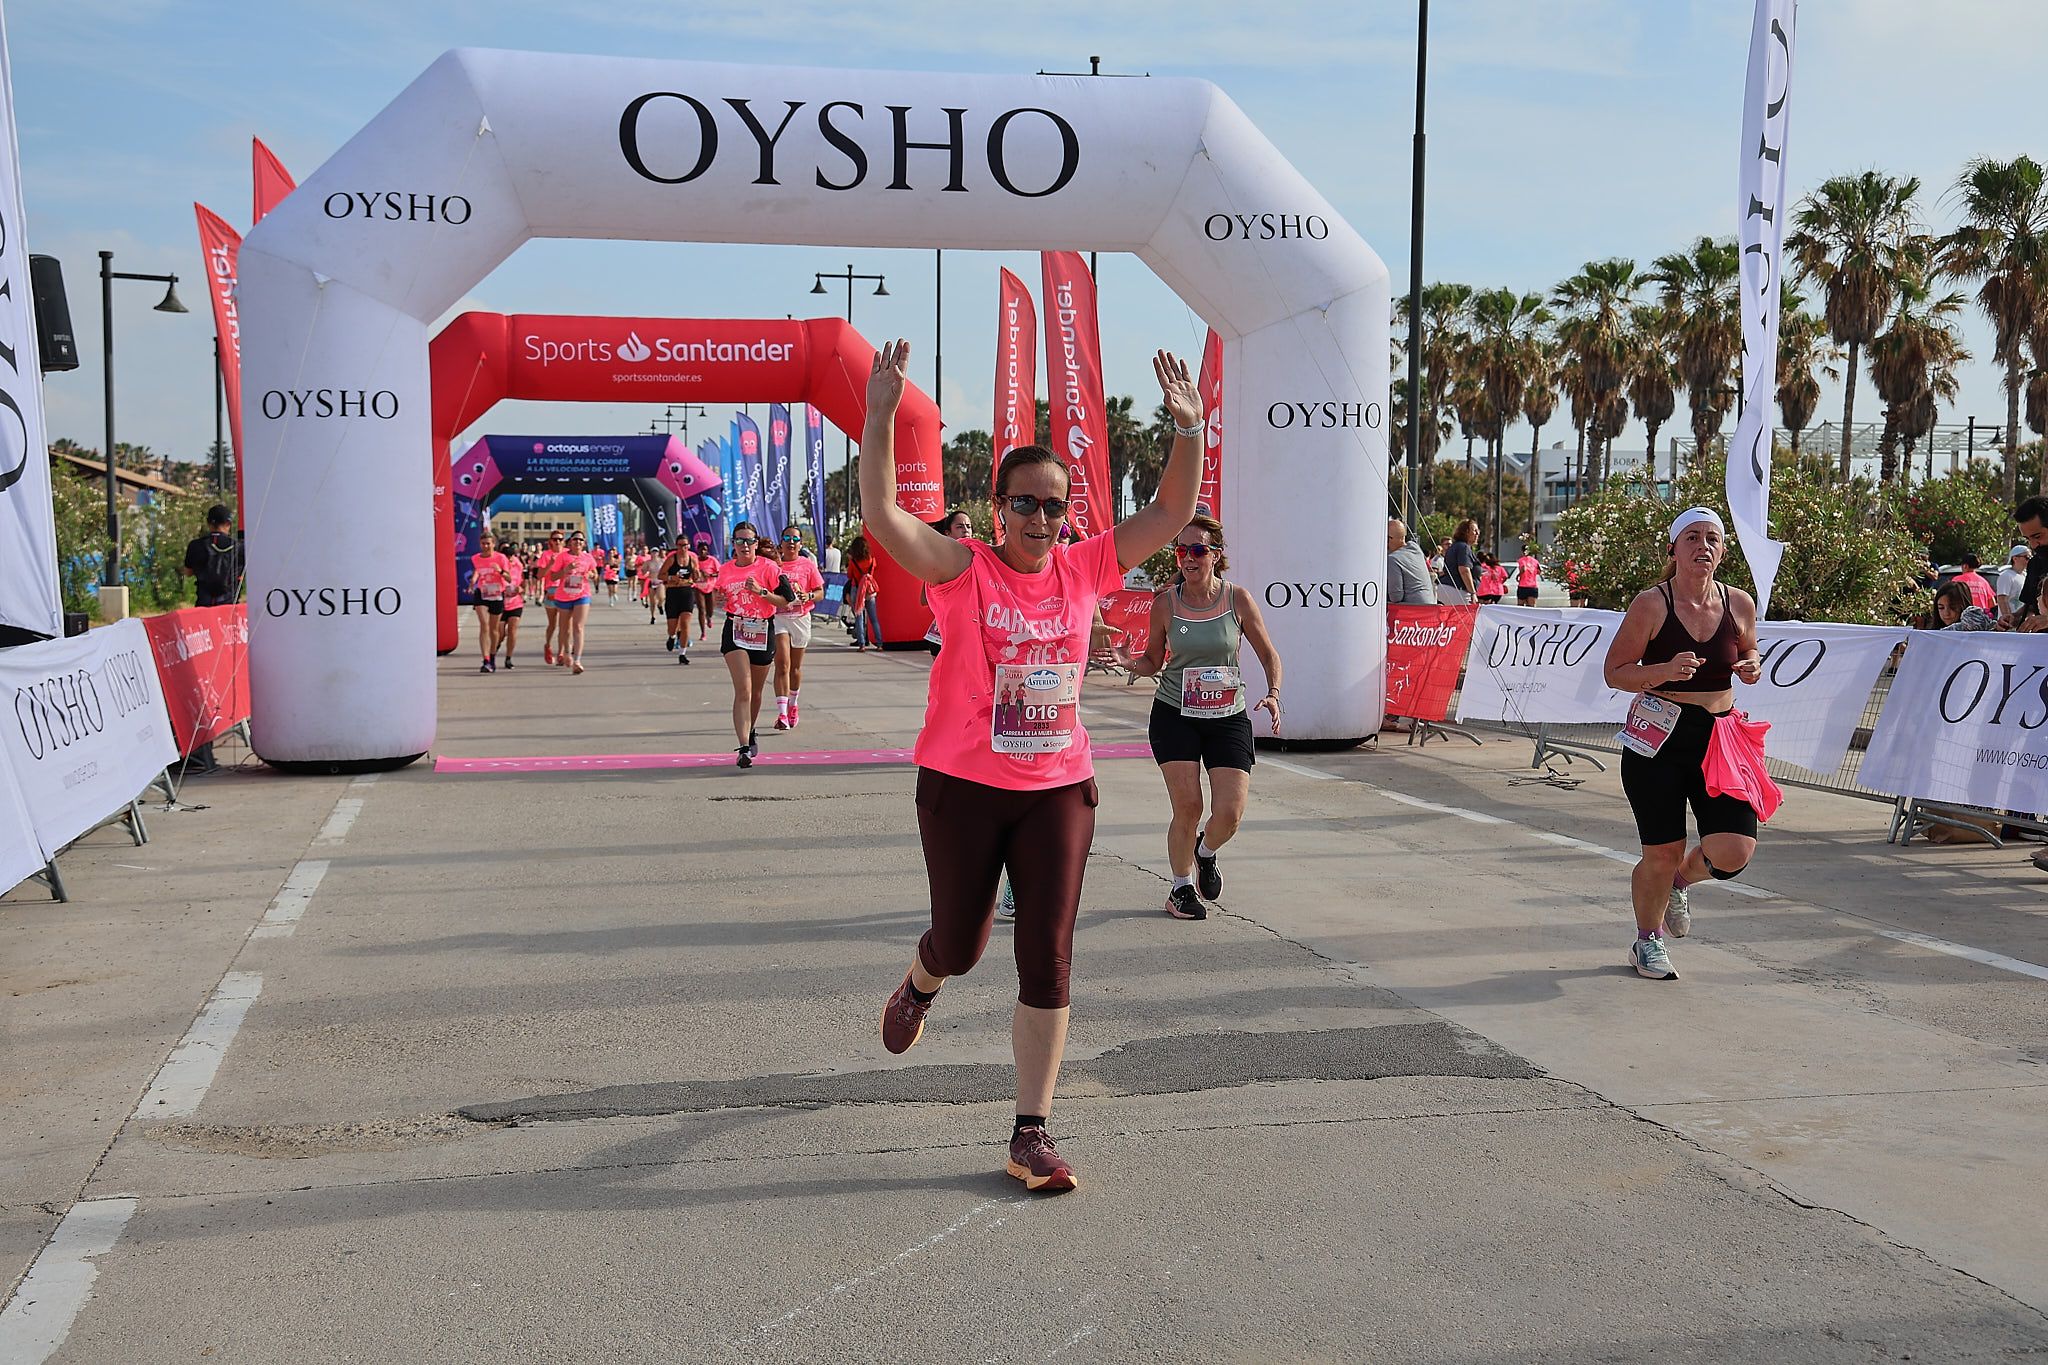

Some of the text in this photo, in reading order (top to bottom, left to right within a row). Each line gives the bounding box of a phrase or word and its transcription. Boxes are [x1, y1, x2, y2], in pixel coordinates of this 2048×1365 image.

[619, 91, 1080, 198] OYSHO
[324, 192, 472, 225] OYSHO
[1204, 213, 1329, 241] OYSHO
[525, 335, 794, 366] Sports Santander
[612, 372, 702, 383] sportssantander.es
[262, 389, 399, 420] OYSHO
[1267, 402, 1381, 429] OYSHO
[546, 443, 625, 456] octopus energy
[896, 461, 928, 476] ports
[896, 480, 941, 492] antander
[265, 586, 401, 618] OYSHO
[1264, 581, 1378, 609] OYSHO
[1387, 619, 1457, 647] Santander
[1488, 623, 1602, 669] OYSHO
[1201, 690, 1223, 700] 016
[1939, 659, 2048, 730] OYS
[15, 669, 103, 760] OYSHO
[1025, 705, 1058, 720] 016
